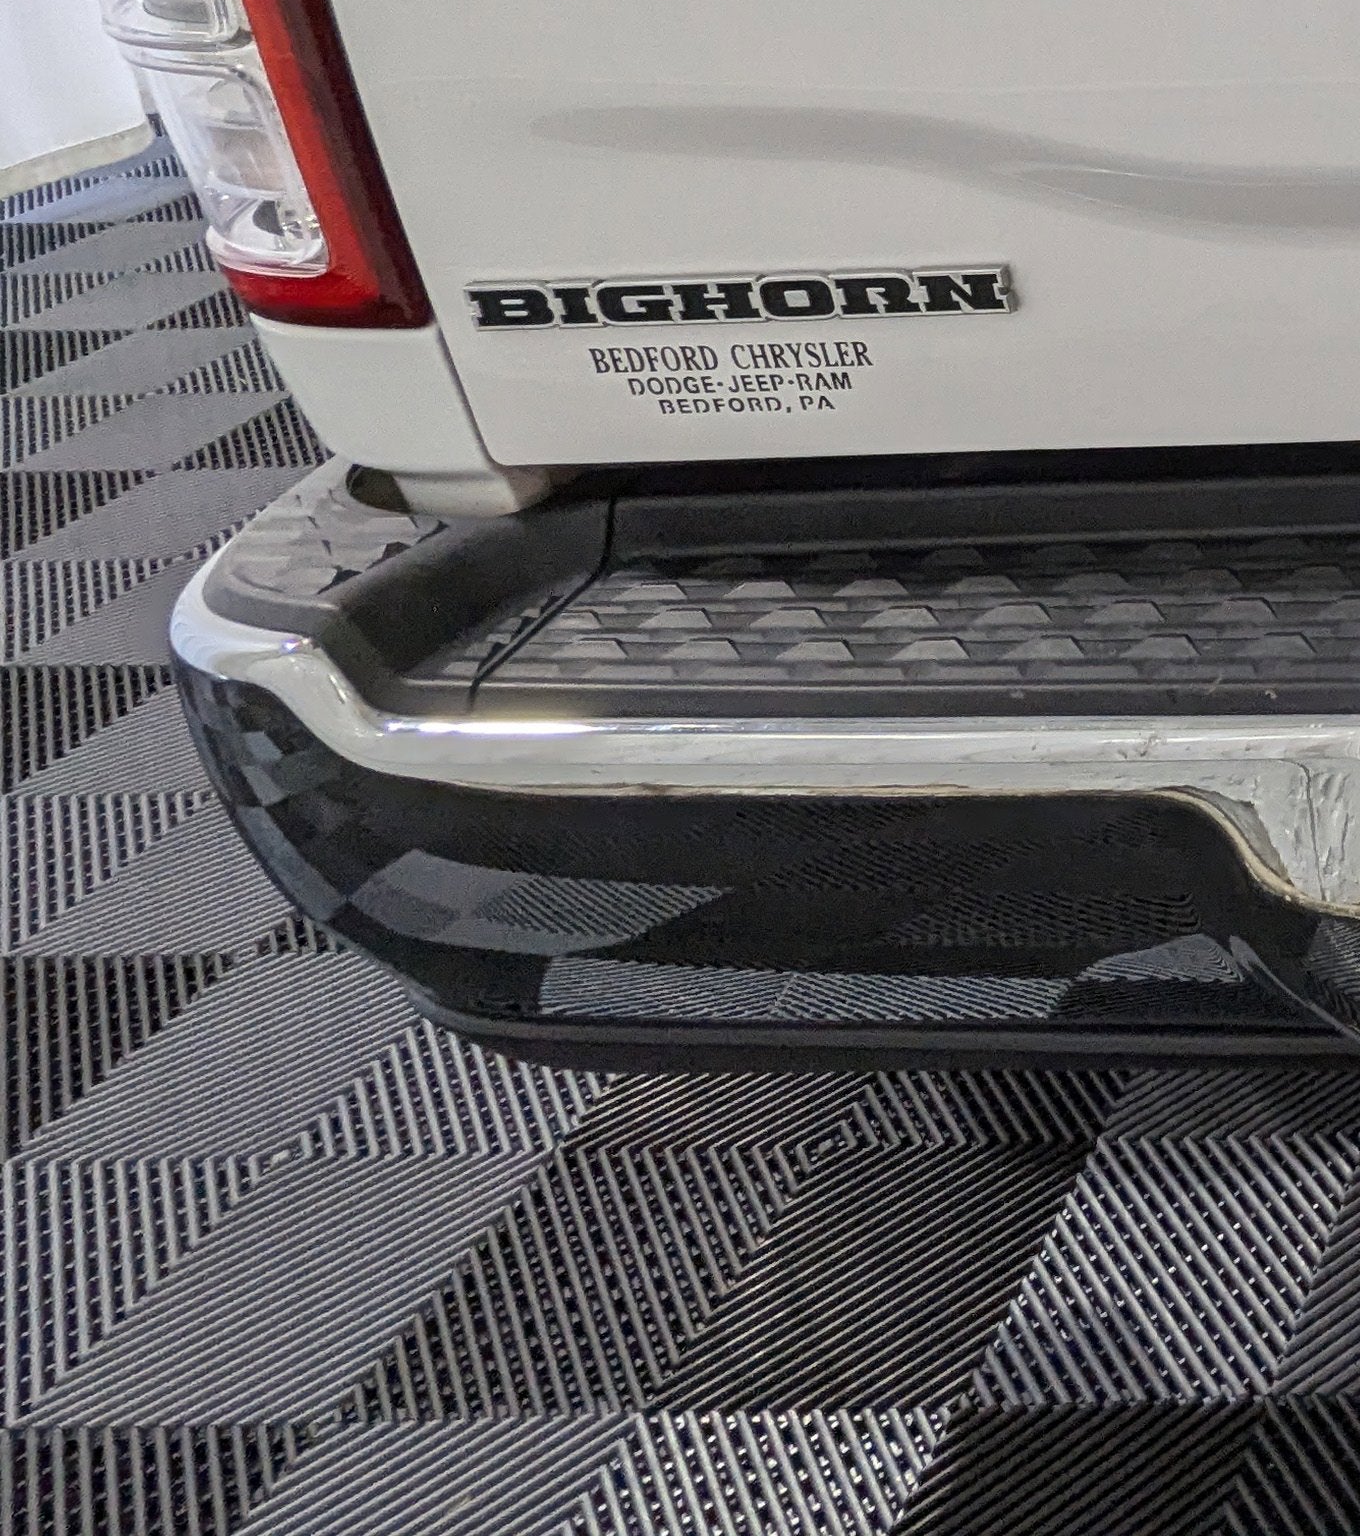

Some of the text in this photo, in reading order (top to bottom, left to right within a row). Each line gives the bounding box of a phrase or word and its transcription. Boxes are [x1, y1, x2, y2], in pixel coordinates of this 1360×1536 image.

[465, 264, 1013, 331] BIGHORN
[588, 341, 874, 375] BEDFORD CHRYSLER
[658, 395, 836, 415] BEDFORD, PA
